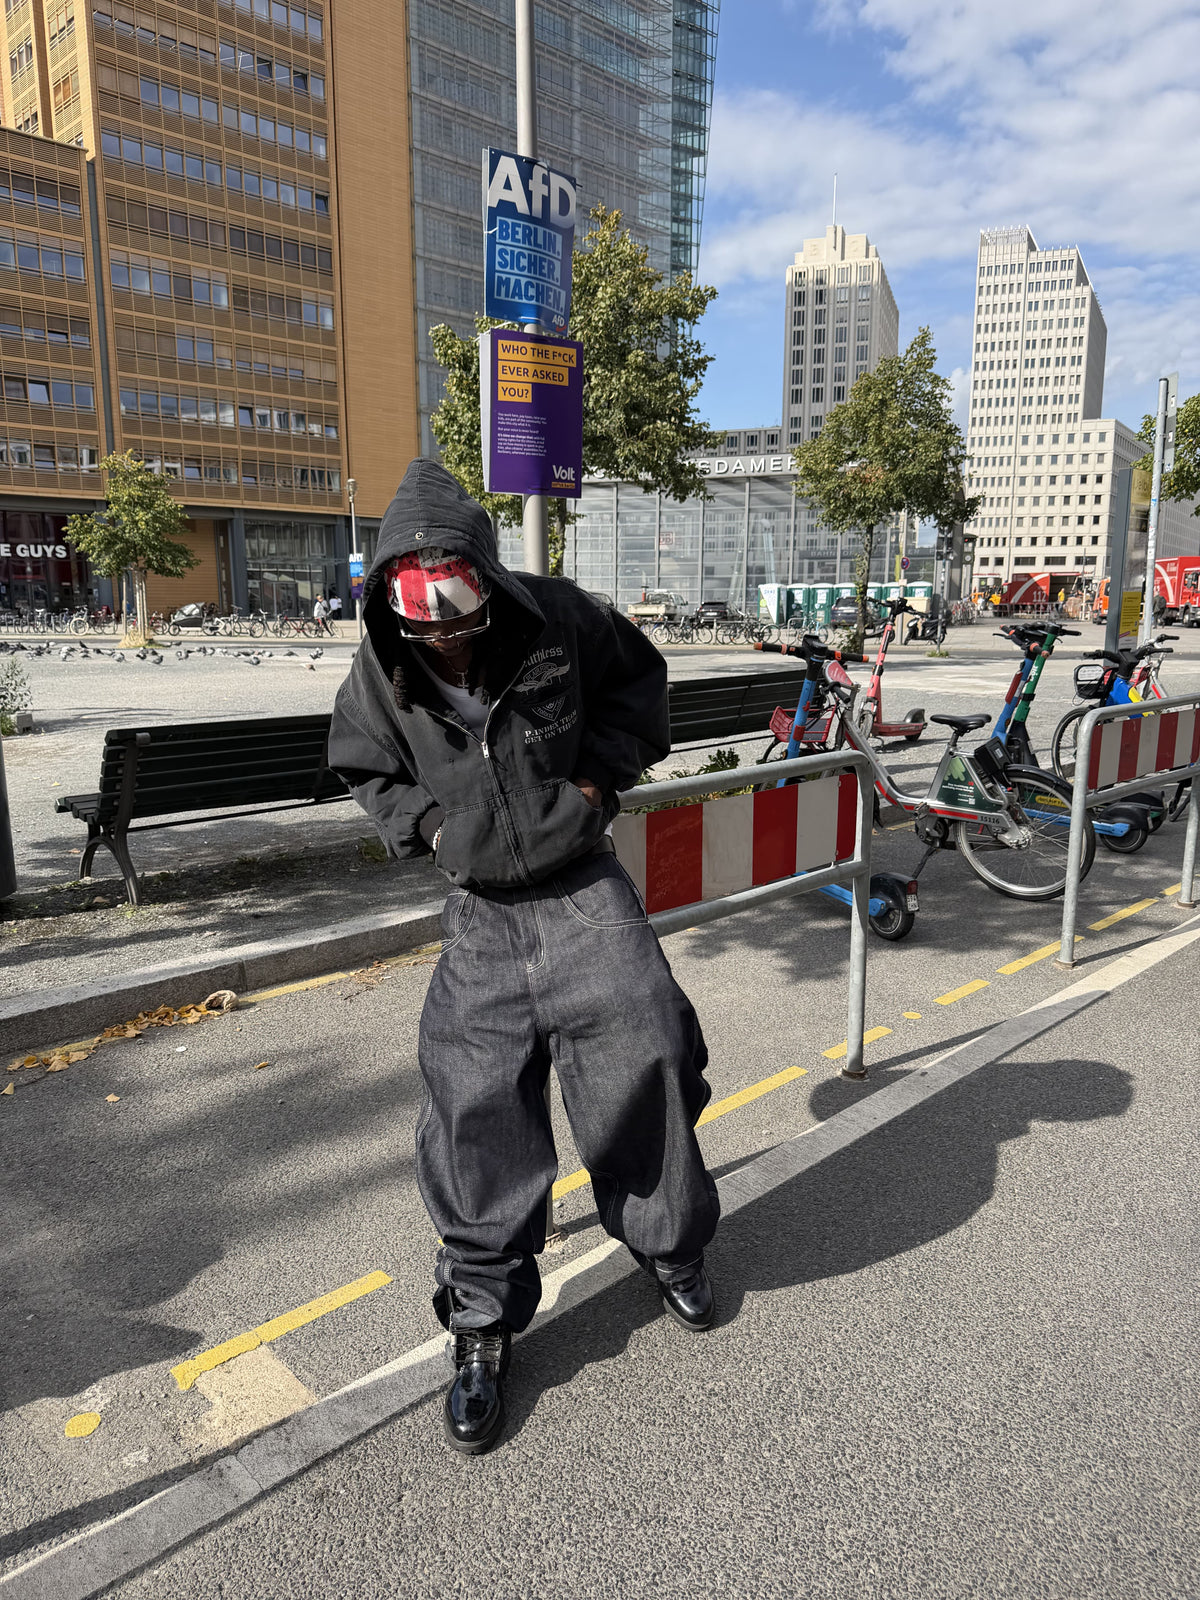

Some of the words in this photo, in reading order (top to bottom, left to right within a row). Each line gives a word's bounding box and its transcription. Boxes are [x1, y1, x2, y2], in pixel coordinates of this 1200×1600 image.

[488, 155, 576, 229] AfD
[498, 219, 561, 257] BERLIN.
[497, 247, 560, 283] SICHER.
[496, 275, 564, 312] MACHEN.
[551, 314, 565, 327] AfD
[501, 343, 528, 356] WHO
[531, 347, 550, 360] THE
[501, 365, 529, 378] EVER
[532, 369, 565, 383] ASKED
[501, 386, 529, 399] YOU?
[552, 464, 576, 482] Volt
[683, 456, 797, 475] SDAME
[16, 544, 67, 559] GUYS
[1032, 590, 1047, 603] 112
[524, 645, 564, 667] uthless
[545, 730, 556, 739] ON
